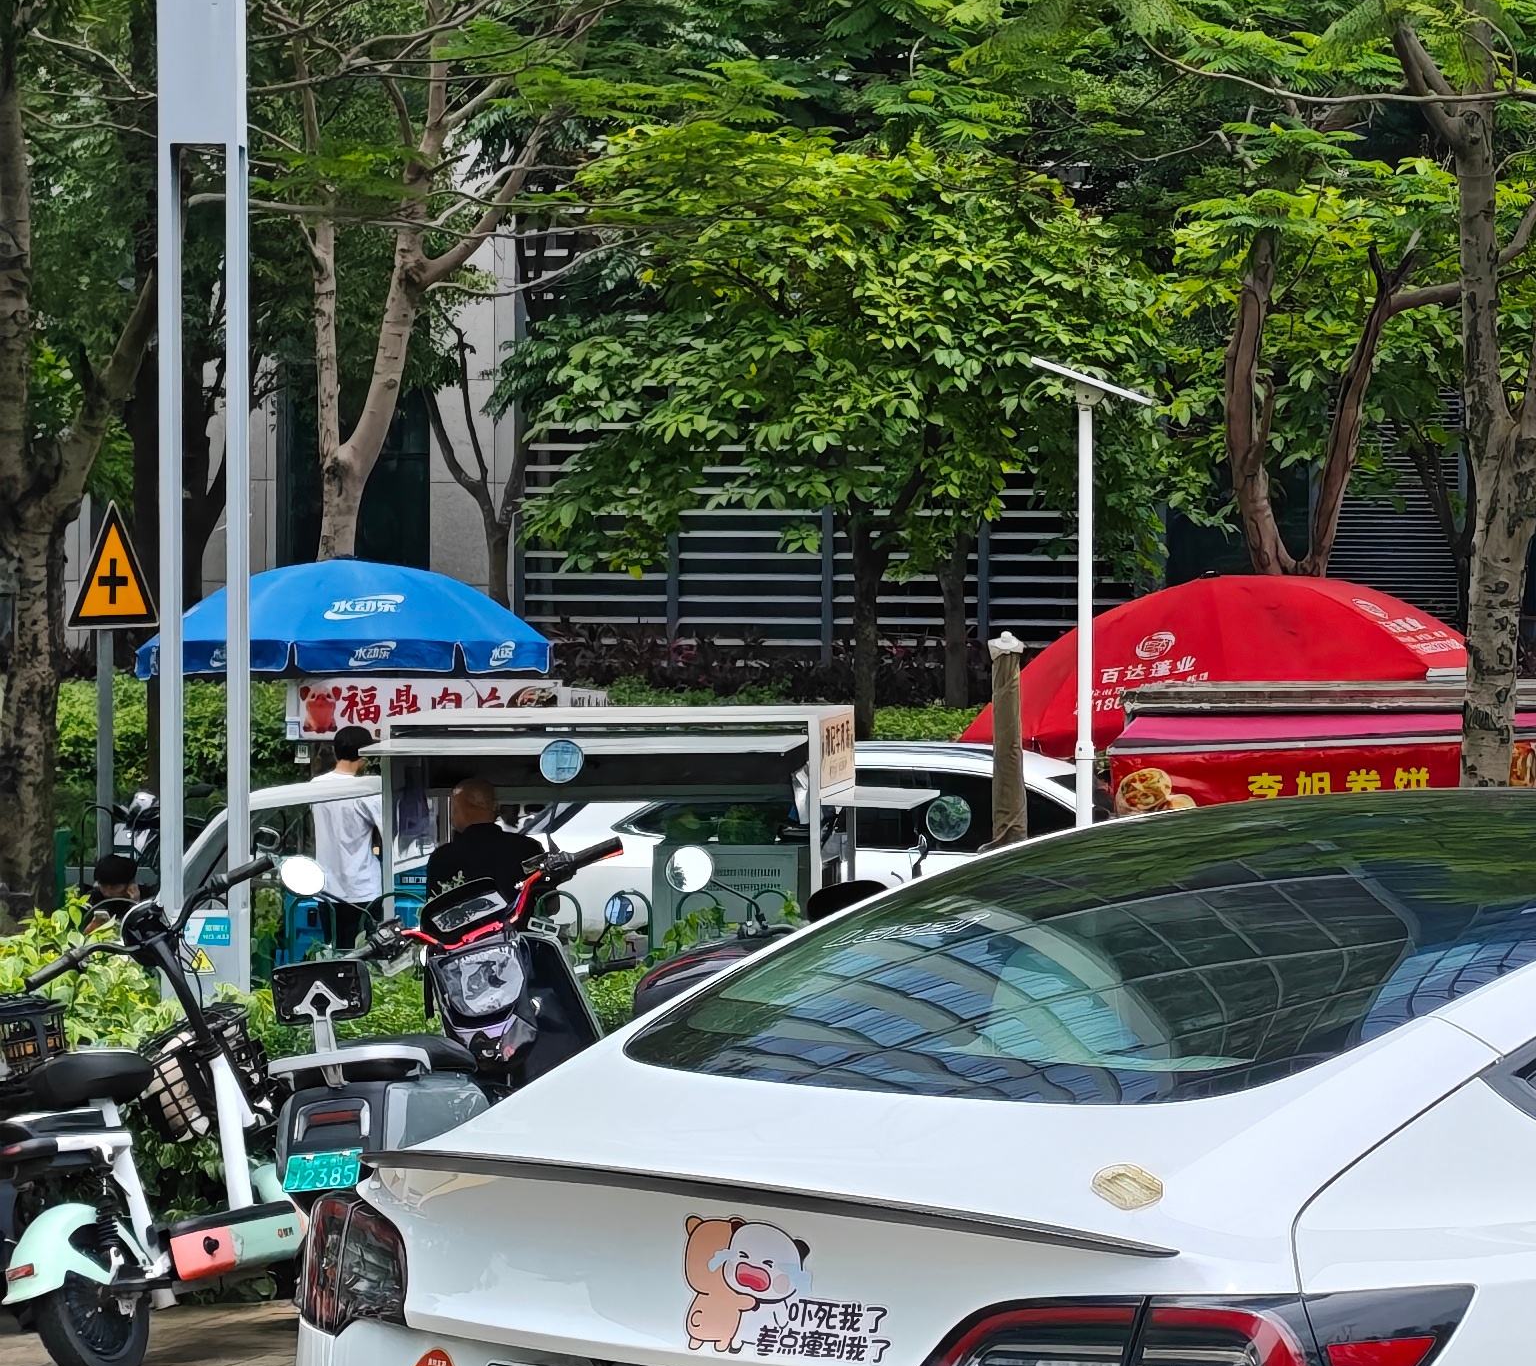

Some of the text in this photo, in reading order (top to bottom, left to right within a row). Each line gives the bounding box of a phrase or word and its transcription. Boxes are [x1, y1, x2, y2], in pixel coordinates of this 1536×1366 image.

[331, 598, 398, 614] 水动乐
[353, 646, 392, 661] 水动乐
[788, 1298, 888, 1334] 吓死我了
[756, 1325, 892, 1364] 差点撞到我了
